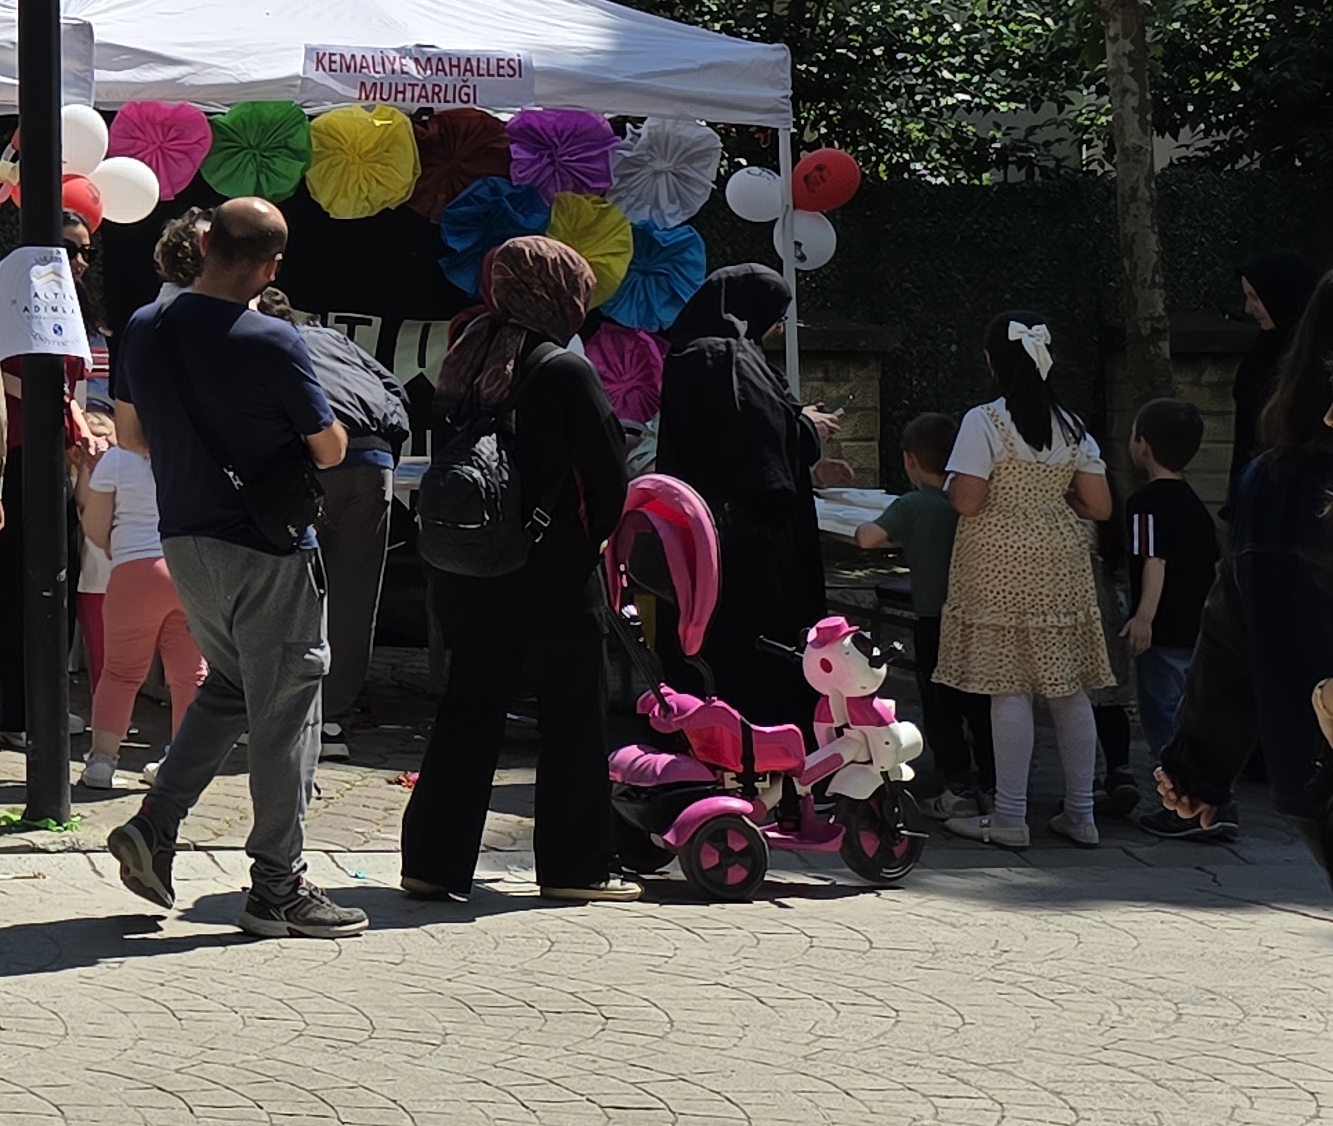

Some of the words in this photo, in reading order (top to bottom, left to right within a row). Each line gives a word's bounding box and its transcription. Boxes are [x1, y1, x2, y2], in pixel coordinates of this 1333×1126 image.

[314, 50, 409, 75] KEMALİYE
[414, 53, 523, 79] MAHALLESİ
[357, 80, 478, 105] MUHTARLIĞI
